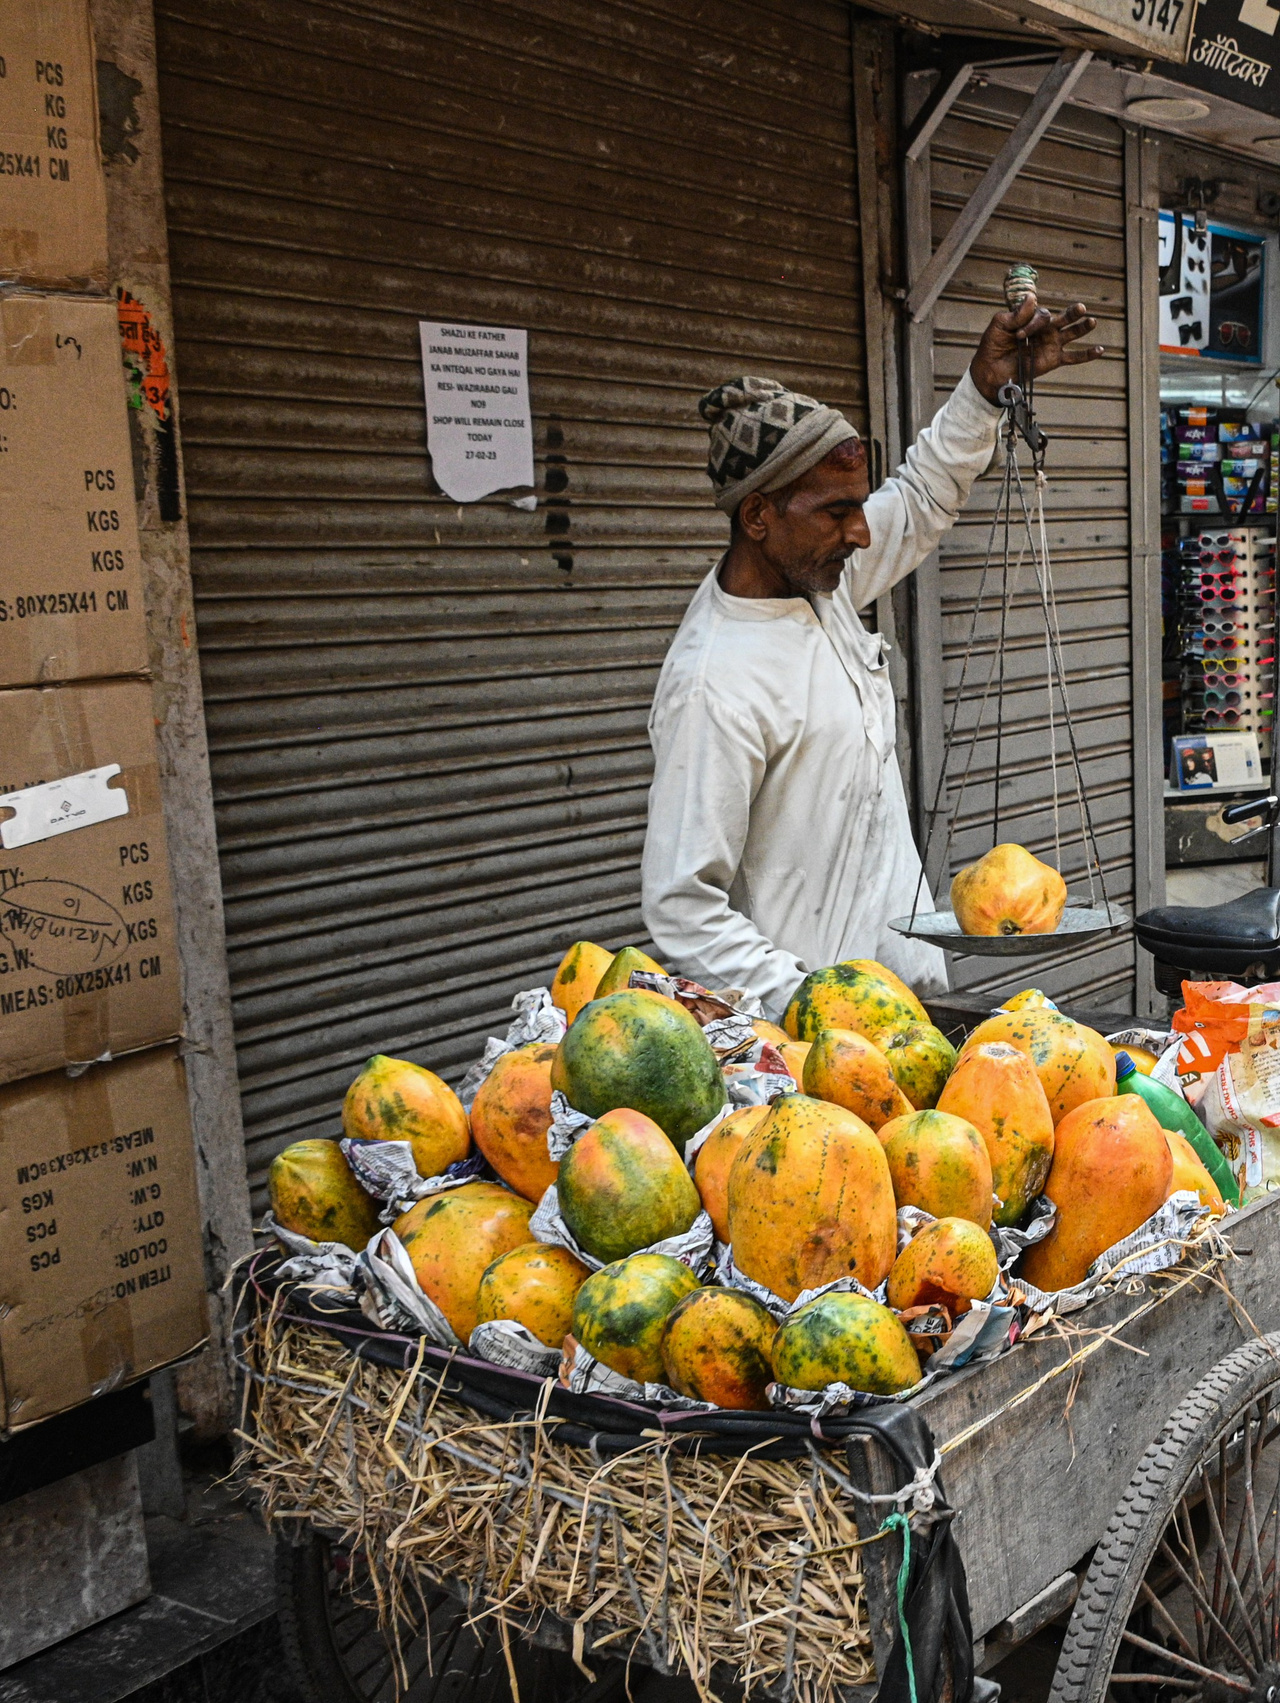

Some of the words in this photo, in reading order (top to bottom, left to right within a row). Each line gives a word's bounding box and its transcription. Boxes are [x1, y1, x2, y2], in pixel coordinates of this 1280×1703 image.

[35, 60, 64, 87] PCS
[44, 94, 66, 119] KG
[46, 126, 68, 150] KG
[49, 158, 70, 182] CM
[478, 331, 506, 341] FATHER
[429, 346, 453, 356] JANAB
[454, 347, 494, 358] MUZAFFAR
[495, 350, 519, 360] SAHAB
[431, 364, 441, 373] KA
[443, 364, 473, 375] INTEQAL
[475, 366, 486, 375] HO
[488, 367, 507, 377] GAYA
[457, 383, 500, 394] WAZIRABAD
[433, 416, 452, 425] SHOP
[454, 417, 471, 426] WILL
[472, 417, 502, 427] REMAIN
[504, 419, 525, 428] CLOSE
[467, 434, 493, 442] TODAY
[465, 451, 497, 460] 27-02-23
[84, 470, 116, 492] PCS
[87, 510, 120, 532] KGS
[92, 550, 125, 573] KGS
[106, 590, 129, 612] CM
[119, 842, 150, 866] PCS
[122, 881, 154, 905] KGS
[127, 918, 158, 944] KGS
[139, 956, 161, 980] CM
[127, 1156, 158, 1178] N.W:
[21, 1189, 54, 1214] KGS
[130, 1183, 161, 1206] G.W:
[26, 1219, 57, 1243] PCS
[133, 1210, 164, 1234] QTY:
[30, 1248, 61, 1272] PCS
[115, 1238, 168, 1270] COLOR:
[111, 1278, 136, 1299] NO:
[139, 1265, 171, 1291] ITEM
